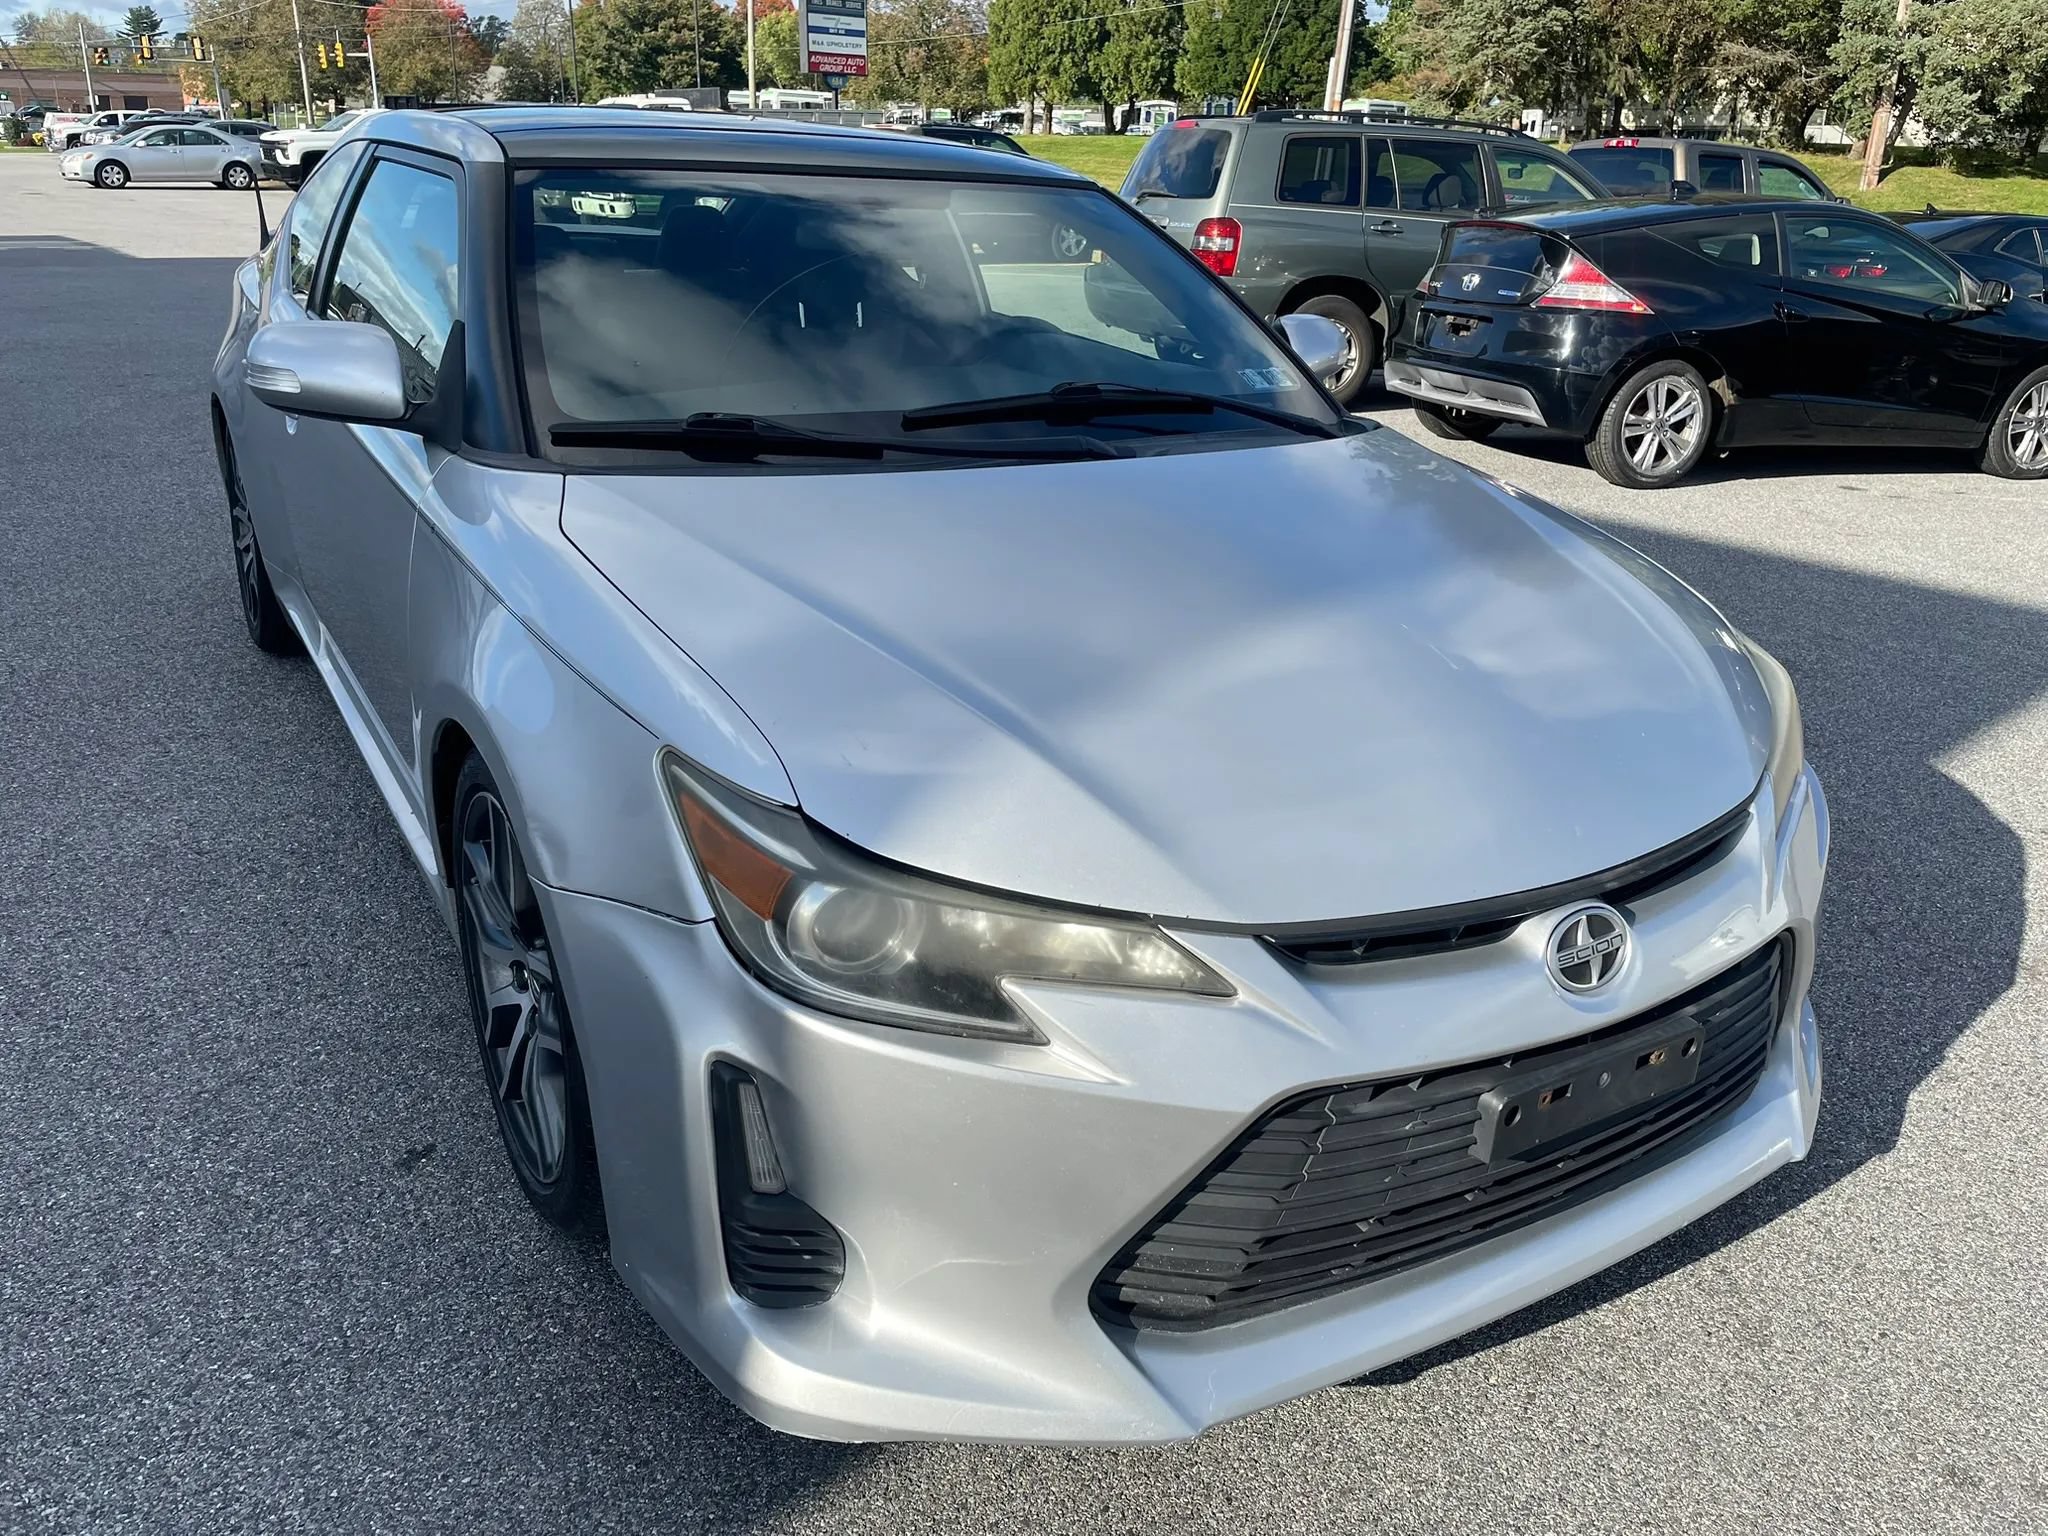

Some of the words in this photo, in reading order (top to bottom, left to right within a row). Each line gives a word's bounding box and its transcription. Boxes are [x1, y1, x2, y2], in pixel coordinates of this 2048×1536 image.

[810, 55, 846, 65] ADVANCED
[846, 57, 865, 66] AUTO
[819, 64, 843, 72] GROUP
